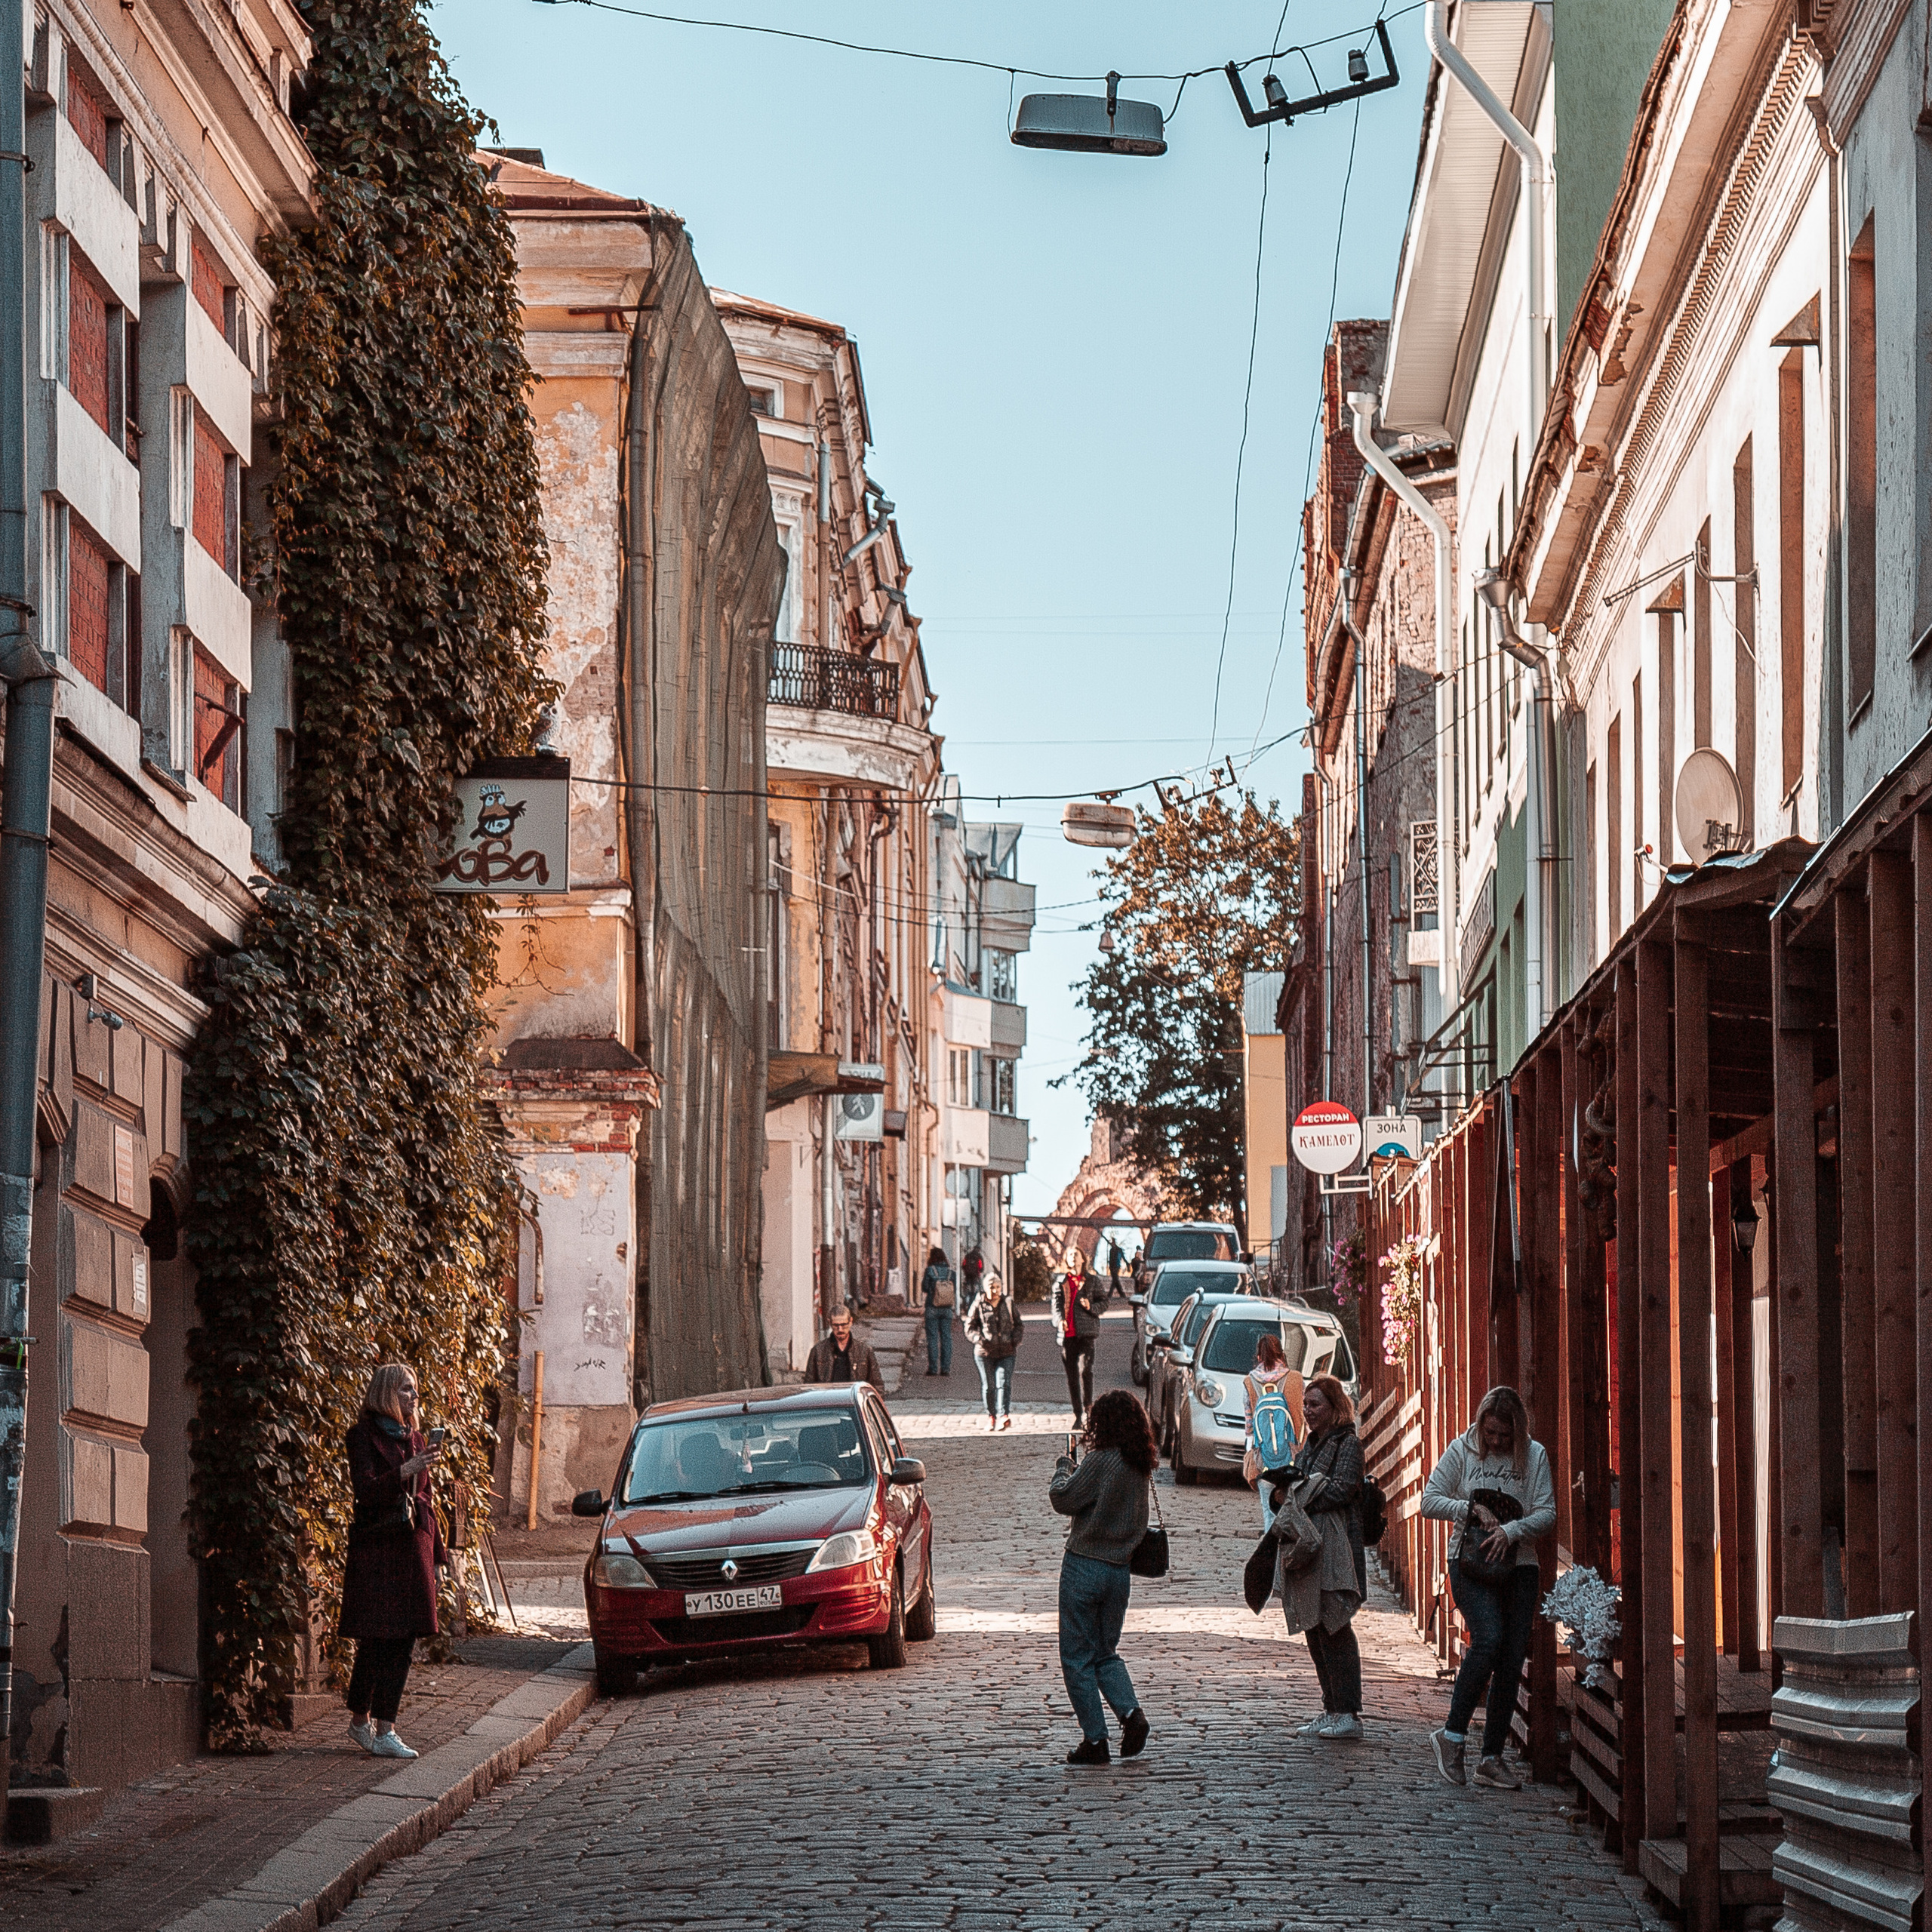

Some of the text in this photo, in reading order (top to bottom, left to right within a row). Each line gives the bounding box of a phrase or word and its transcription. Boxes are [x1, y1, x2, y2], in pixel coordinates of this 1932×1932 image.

[1302, 1113, 1349, 1124] РЕСТОРАН
[1377, 1123, 1407, 1133] ЗОНА
[1300, 1134, 1355, 1149] КАМЕЛОТ
[760, 1587, 775, 1601] 47
